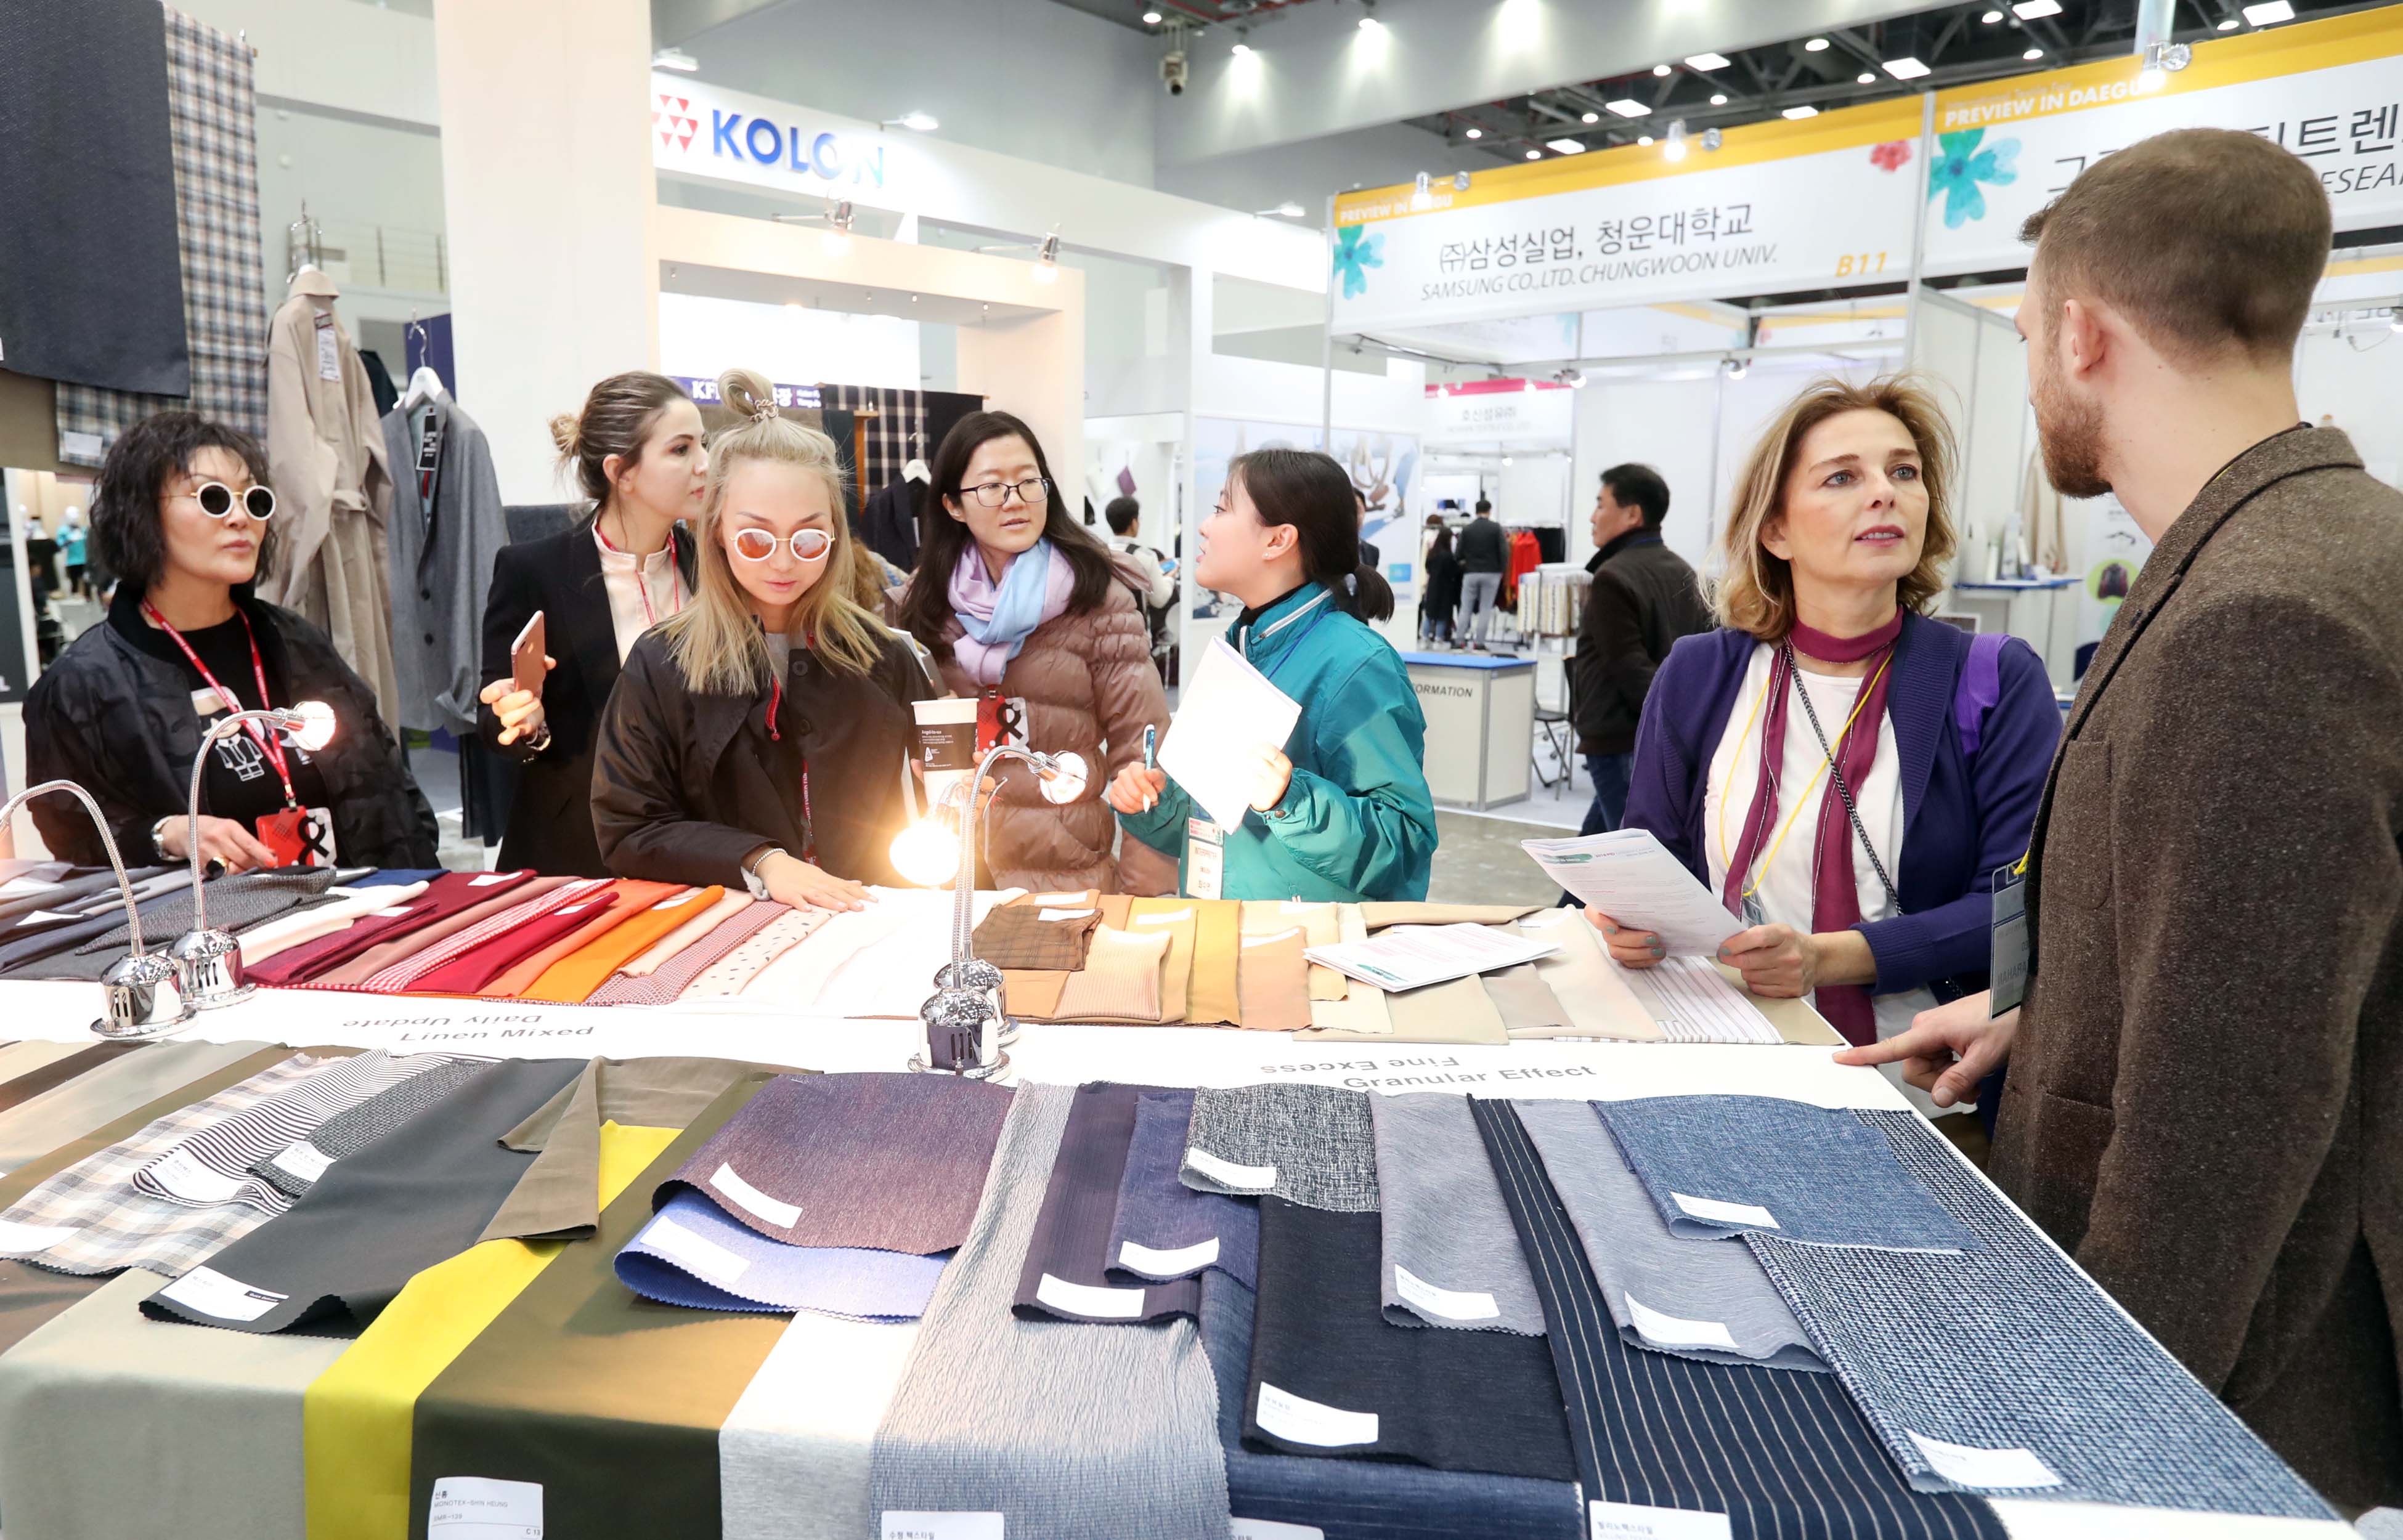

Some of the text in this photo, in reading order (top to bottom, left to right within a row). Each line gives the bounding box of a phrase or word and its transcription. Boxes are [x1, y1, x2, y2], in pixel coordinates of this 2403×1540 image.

[1945, 98, 2036, 127] PREVIEW
[2039, 92, 2064, 111] IN
[712, 108, 884, 188] KOLON
[1340, 203, 1391, 222] PREVIEW
[1393, 201, 1409, 215] IN
[1596, 203, 1753, 256] 청운대학교
[1421, 275, 1503, 301] SAMSUNG
[1579, 250, 1719, 284] CHUNGWOON
[1723, 243, 1778, 269] UNIV.
[1834, 250, 1887, 277] B11
[1414, 684, 1473, 697] ORMATION
[343, 1015, 543, 1027] Daily Update
[399, 1026, 595, 1042] Linen Mixed
[1260, 1056, 1460, 1074] Fine Excess
[1343, 1065, 1597, 1088] Granular Effect
